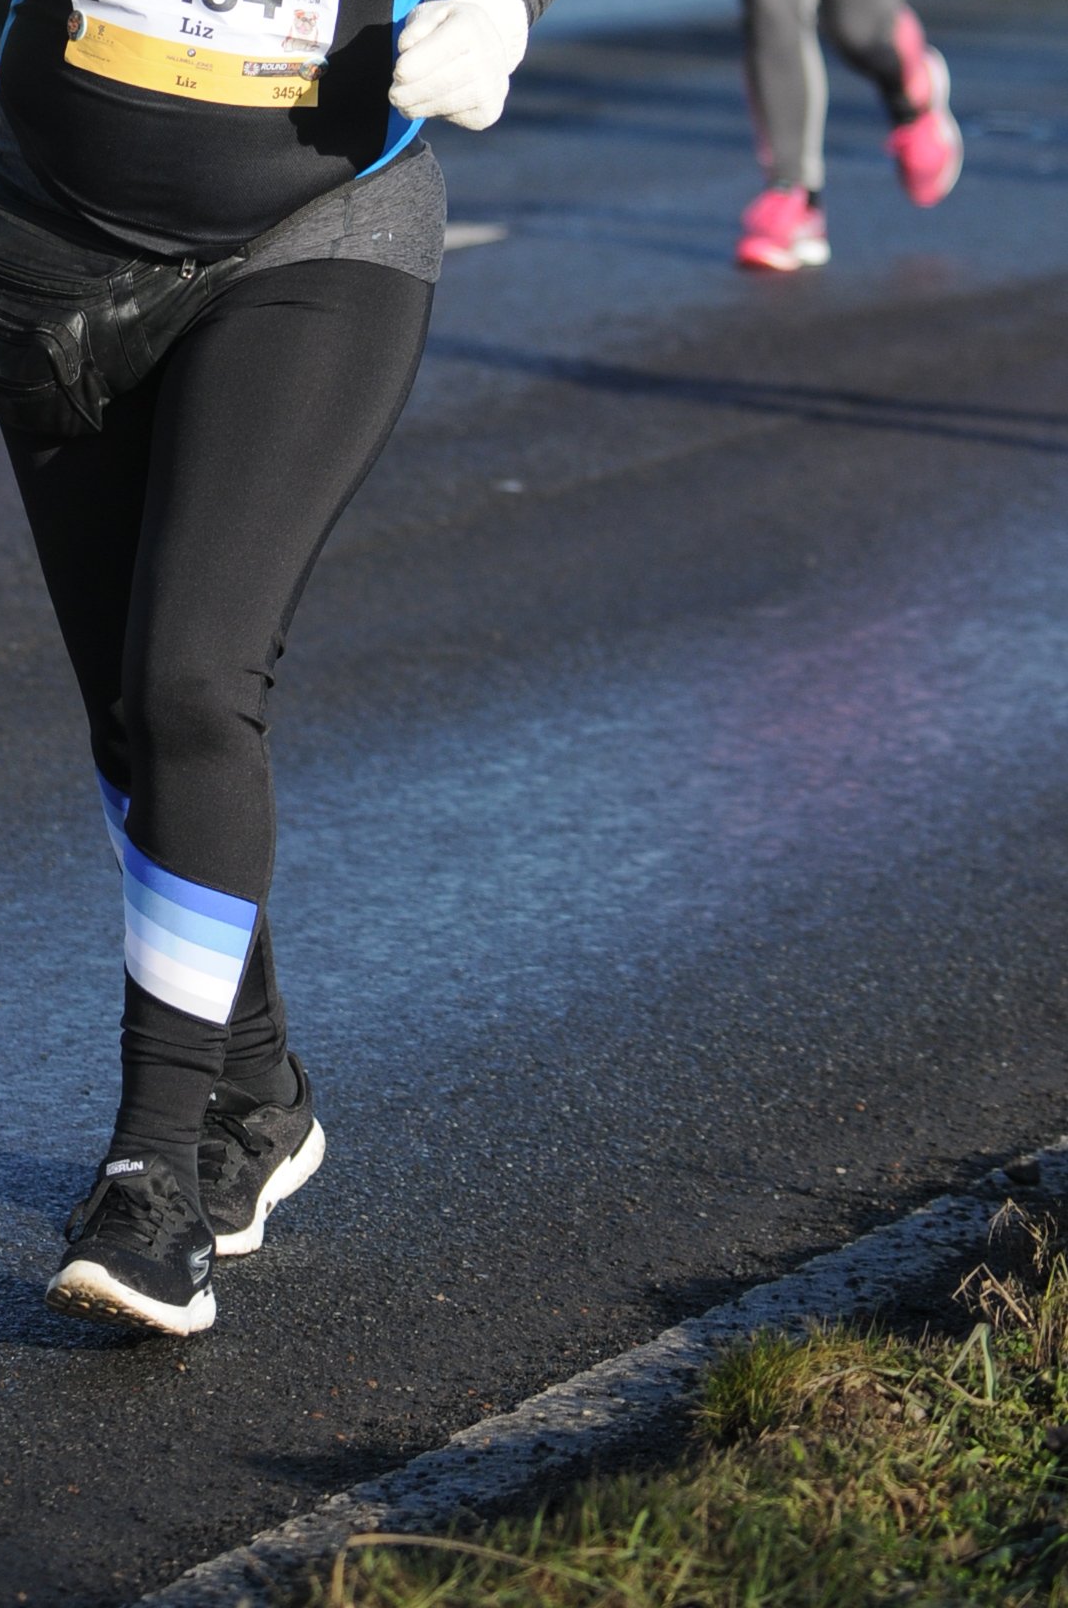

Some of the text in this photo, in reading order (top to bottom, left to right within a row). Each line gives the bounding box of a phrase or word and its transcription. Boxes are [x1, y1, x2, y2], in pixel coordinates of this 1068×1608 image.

[180, 16, 214, 39] Liz
[175, 75, 197, 89] Liz
[272, 86, 303, 99] 3454
